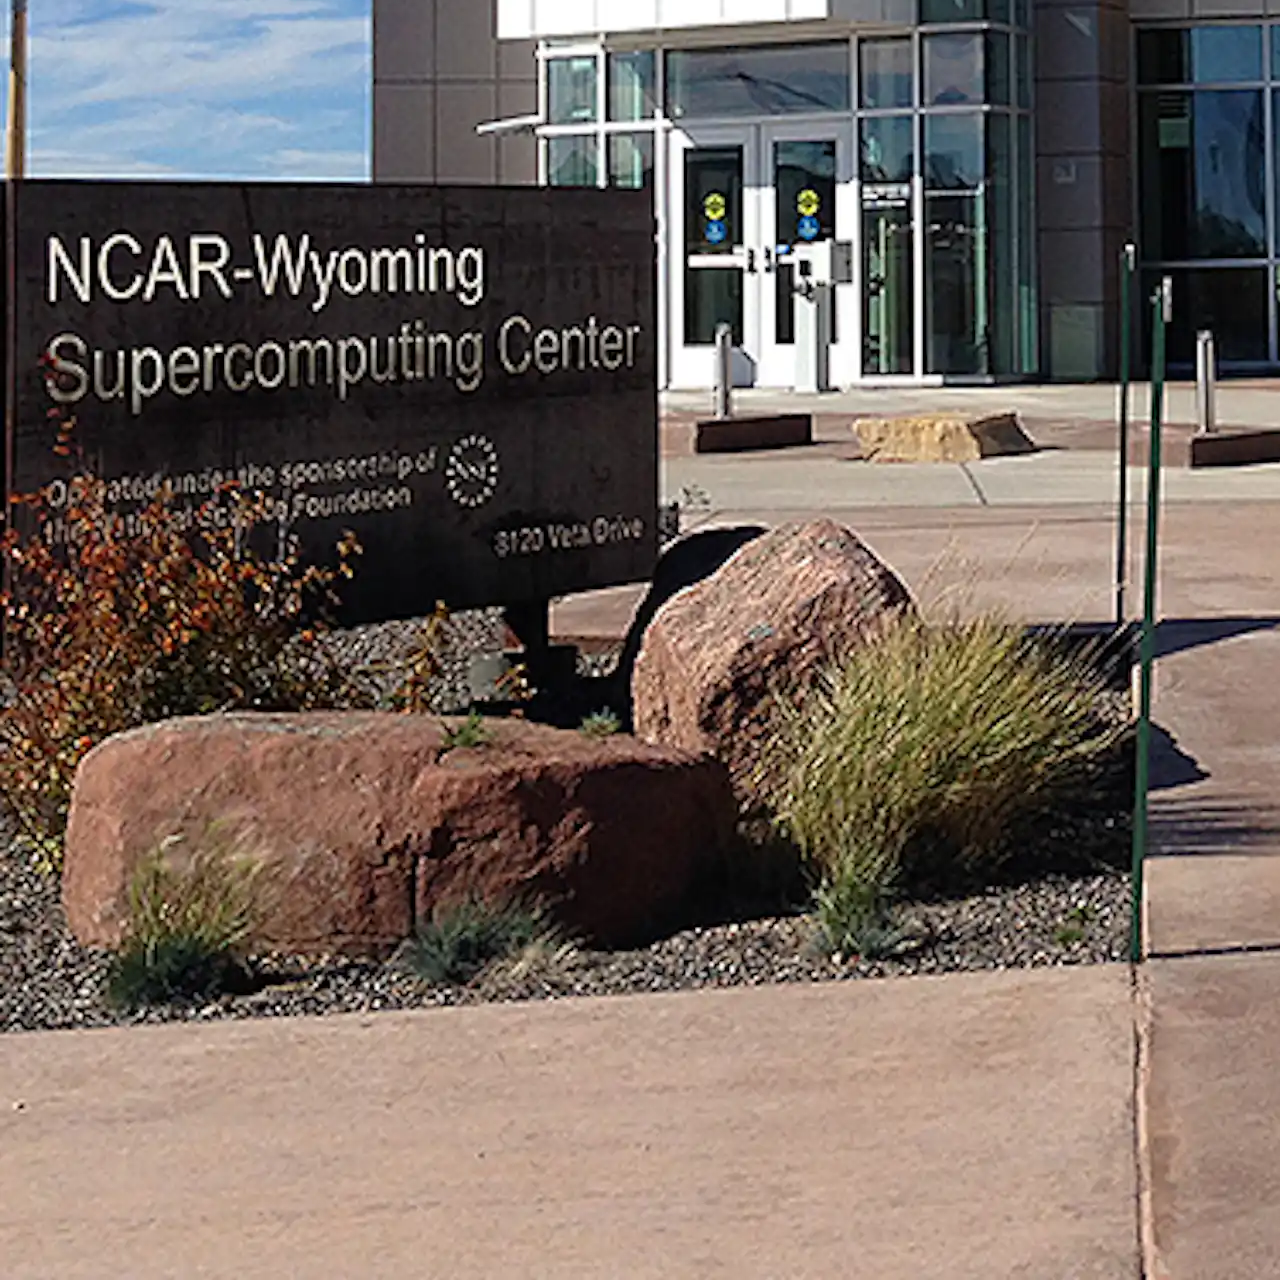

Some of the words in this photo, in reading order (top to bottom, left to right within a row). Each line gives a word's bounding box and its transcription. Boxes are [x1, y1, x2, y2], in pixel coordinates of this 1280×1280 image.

[48, 233, 484, 312] NCAR-Wyoming
[46, 320, 484, 415] Supercomputing
[499, 316, 640, 374] Center
[292, 485, 412, 519] Foundation
[592, 516, 645, 545] Drive
